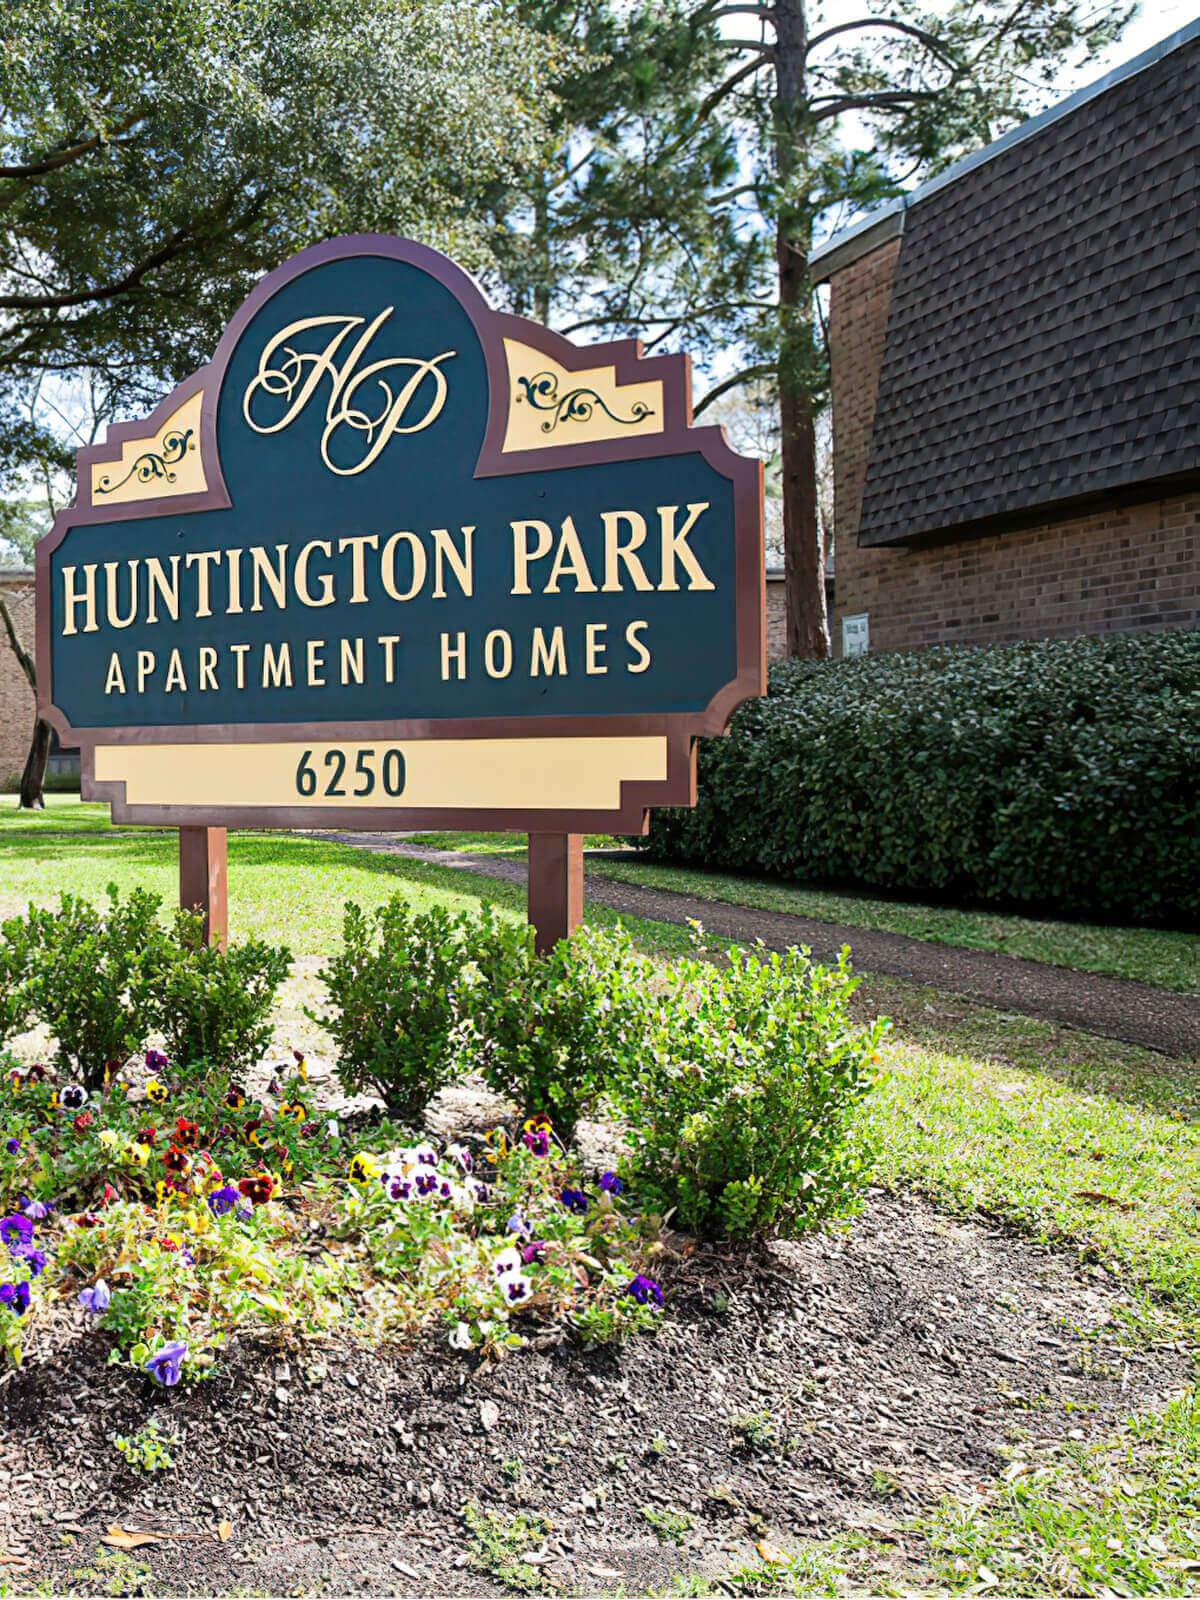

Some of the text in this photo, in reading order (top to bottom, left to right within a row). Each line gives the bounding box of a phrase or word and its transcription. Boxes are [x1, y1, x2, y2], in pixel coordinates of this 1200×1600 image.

[242, 306, 457, 476] HP
[60, 502, 716, 637] HUNTINGTON PARK
[104, 620, 652, 695] APARTMENT HOMES
[295, 748, 407, 797] 6250
